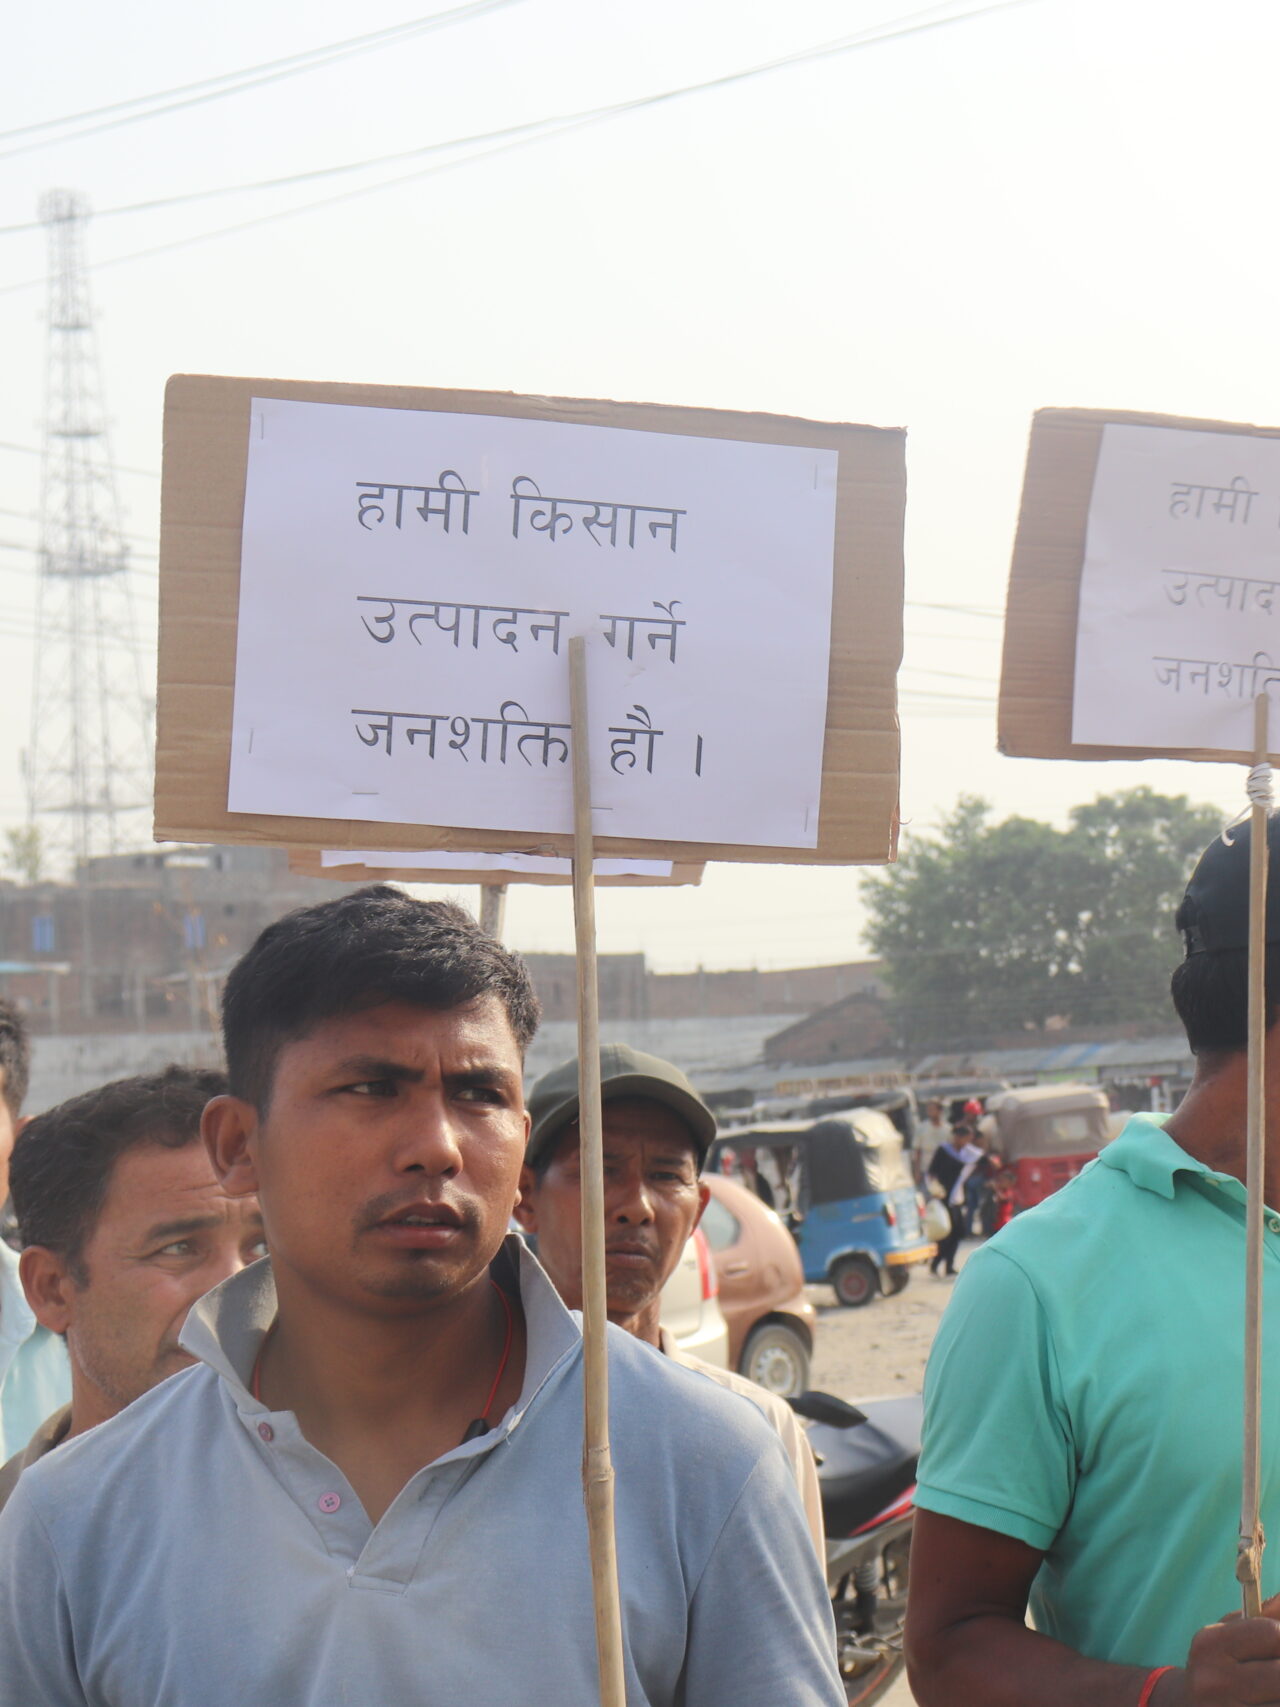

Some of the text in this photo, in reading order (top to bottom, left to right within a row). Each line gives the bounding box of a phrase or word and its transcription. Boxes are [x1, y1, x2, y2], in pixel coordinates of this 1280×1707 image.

[355, 469, 687, 553] हामी किसान
[1169, 475, 1260, 525] हामी
[356, 595, 687, 665] उत्पादन गर्ने
[350, 700, 570, 768] जनशक्ति
[607, 704, 665, 776] हौ
